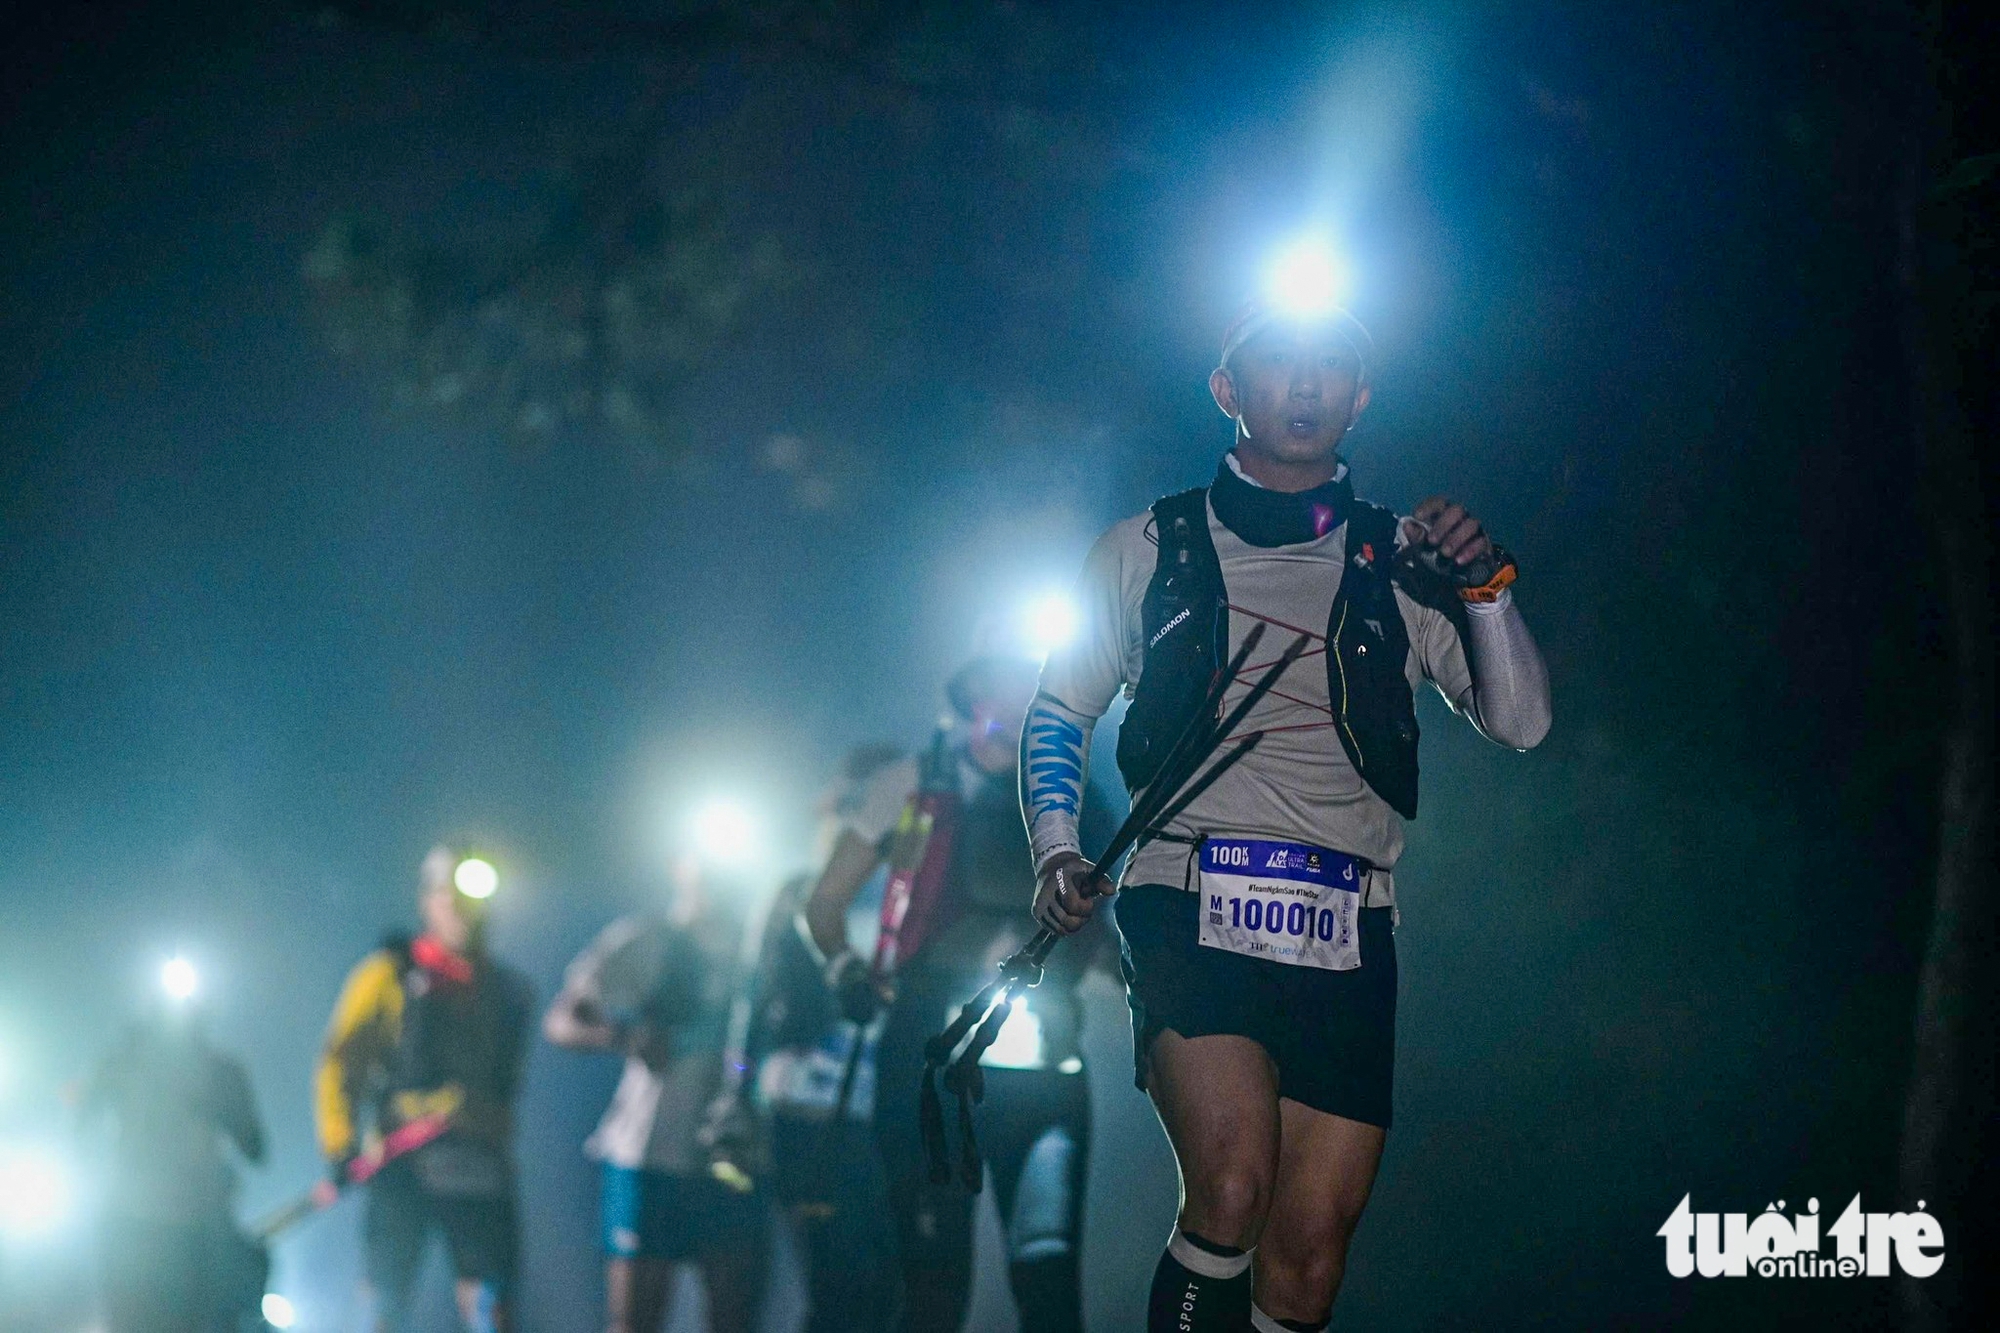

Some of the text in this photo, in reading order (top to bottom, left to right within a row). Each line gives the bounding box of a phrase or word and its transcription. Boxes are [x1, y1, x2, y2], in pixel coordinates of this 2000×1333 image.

[1150, 608, 1191, 649] SALOMON
[1210, 894, 1222, 912] M
[1229, 897, 1334, 942] 100010
[1179, 1282, 1200, 1332] SPORT
